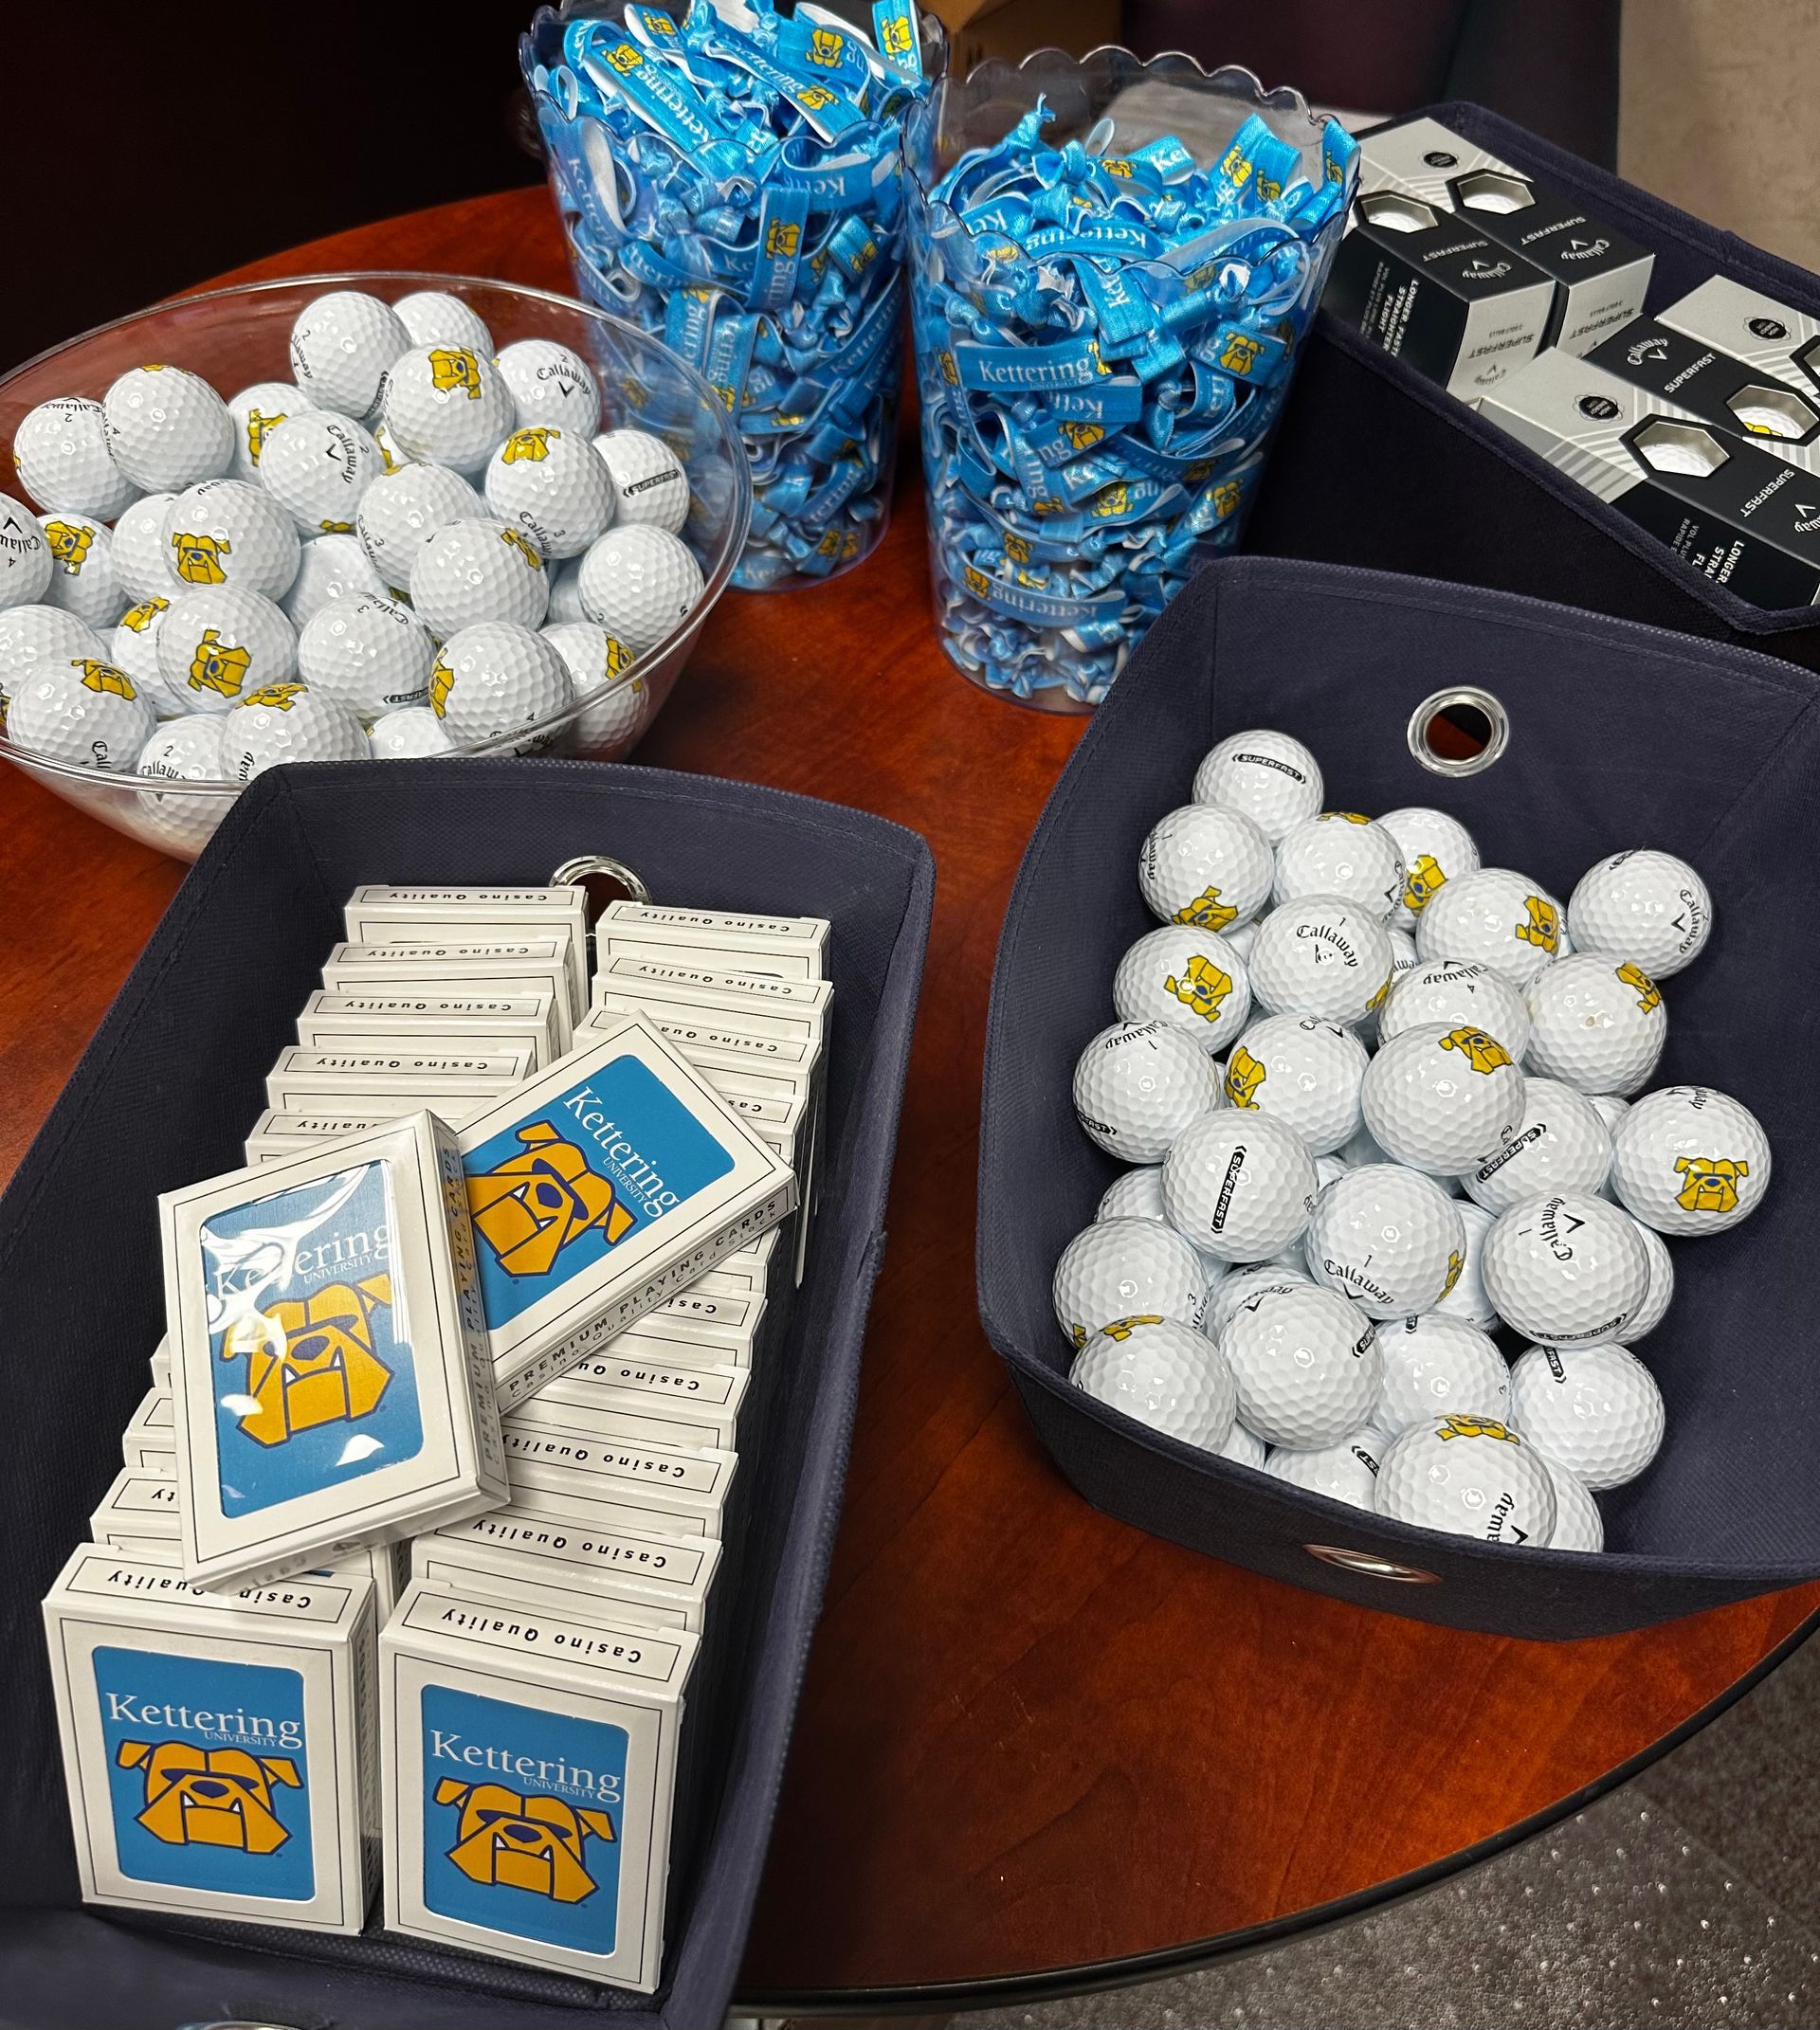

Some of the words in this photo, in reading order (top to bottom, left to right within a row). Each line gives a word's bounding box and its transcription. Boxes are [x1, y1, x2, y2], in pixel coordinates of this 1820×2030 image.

[733, 38, 805, 95] ettering
[1521, 216, 1587, 245] SUPERFAST
[1422, 240, 1489, 263] SUPERFAST
[1560, 239, 1611, 261] Callaway
[1462, 262, 1512, 280] Callaway
[301, 329, 311, 341] 2
[292, 334, 314, 379] llaway
[559, 353, 569, 363] 2
[1627, 338, 1668, 366] Callaway
[537, 365, 592, 396] Callaway
[978, 356, 1094, 383] Kettering
[1664, 353, 1717, 393] SUPERFAST
[64, 413, 73, 423] 2
[112, 426, 121, 435] 4
[326, 425, 357, 485] Callaway
[359, 445, 370, 454] 2
[631, 470, 680, 492] SUPERFAST
[1740, 468, 1795, 517] SUPERFAST
[374, 538, 385, 548] 3
[519, 511, 555, 556] Callaw
[554, 529, 566, 538] 3
[1672, 517, 1691, 547] RAPIDE
[1687, 525, 1700, 539] VOL
[9, 557, 16, 568] 4
[1703, 546, 1725, 579] STRAI
[357, 605, 370, 614] 3
[92, 740, 112, 769] Call
[163, 745, 173, 757] 2
[1241, 754, 1301, 780] SUPERFAST
[389, 891, 467, 901] Quality
[479, 893, 548, 901] Casino
[640, 912, 713, 925] Quality
[724, 919, 791, 933] Casino
[1679, 888, 1701, 955] Callaway
[367, 949, 446, 957] Quality
[459, 946, 529, 955] Casino
[1296, 924, 1358, 968] Callaway
[638, 965, 713, 983] Quality
[1423, 964, 1489, 986] Callaway
[724, 978, 792, 994] Casino
[1466, 984, 1475, 994] 4
[345, 1000, 427, 1010] Quality
[439, 1002, 512, 1011] Casino
[708, 1033, 778, 1052] Casino
[1105, 1020, 1168, 1049] Callaway
[317, 1057, 400, 1068] Quality
[413, 1060, 488, 1070] Casino
[727, 1099, 762, 1113] Cas
[297, 1119, 377, 1130] uality
[563, 1085, 680, 1218] Kettering
[1479, 1127, 1539, 1180] SUPERFAST
[443, 1146, 459, 1218] CARDS
[602, 1156, 649, 1203] UNIVERSITY
[1214, 1154, 1242, 1228] SUPERFAST
[1539, 1195, 1574, 1261] Callaway
[214, 1224, 390, 1300] Keering
[303, 1254, 373, 1284] UNIVERSITY
[1363, 1254, 1373, 1268] 1
[454, 1230, 475, 1331] PLAYING
[1323, 1259, 1394, 1305] Callaway
[509, 1317, 608, 1391] PREMIUM
[619, 1250, 704, 1314] PLAYING
[715, 1200, 775, 1247] CARDS
[512, 1349, 579, 1398] Casino
[592, 1289, 664, 1341] Quality
[676, 1251, 716, 1283] Card
[728, 1211, 775, 1247] Stock
[667, 1298, 717, 1314] Casi
[1187, 1293, 1197, 1305] 3
[620, 1368, 701, 1391] Casino
[468, 1343, 494, 1461] PREMIUM
[603, 1453, 685, 1478] Casino
[1486, 1493, 1515, 1542] away
[472, 1520, 568, 1550] Quality
[581, 1541, 667, 1568] Casino
[239, 1590, 312, 1609] Casin
[441, 1608, 540, 1642] Quality
[554, 1633, 643, 1664] Casino
[105, 1692, 303, 1750] Kettering
[204, 1730, 278, 1748] UNIVERSITY
[429, 1728, 622, 1803] Kettering
[522, 1776, 596, 1799] UNIVERSITY
